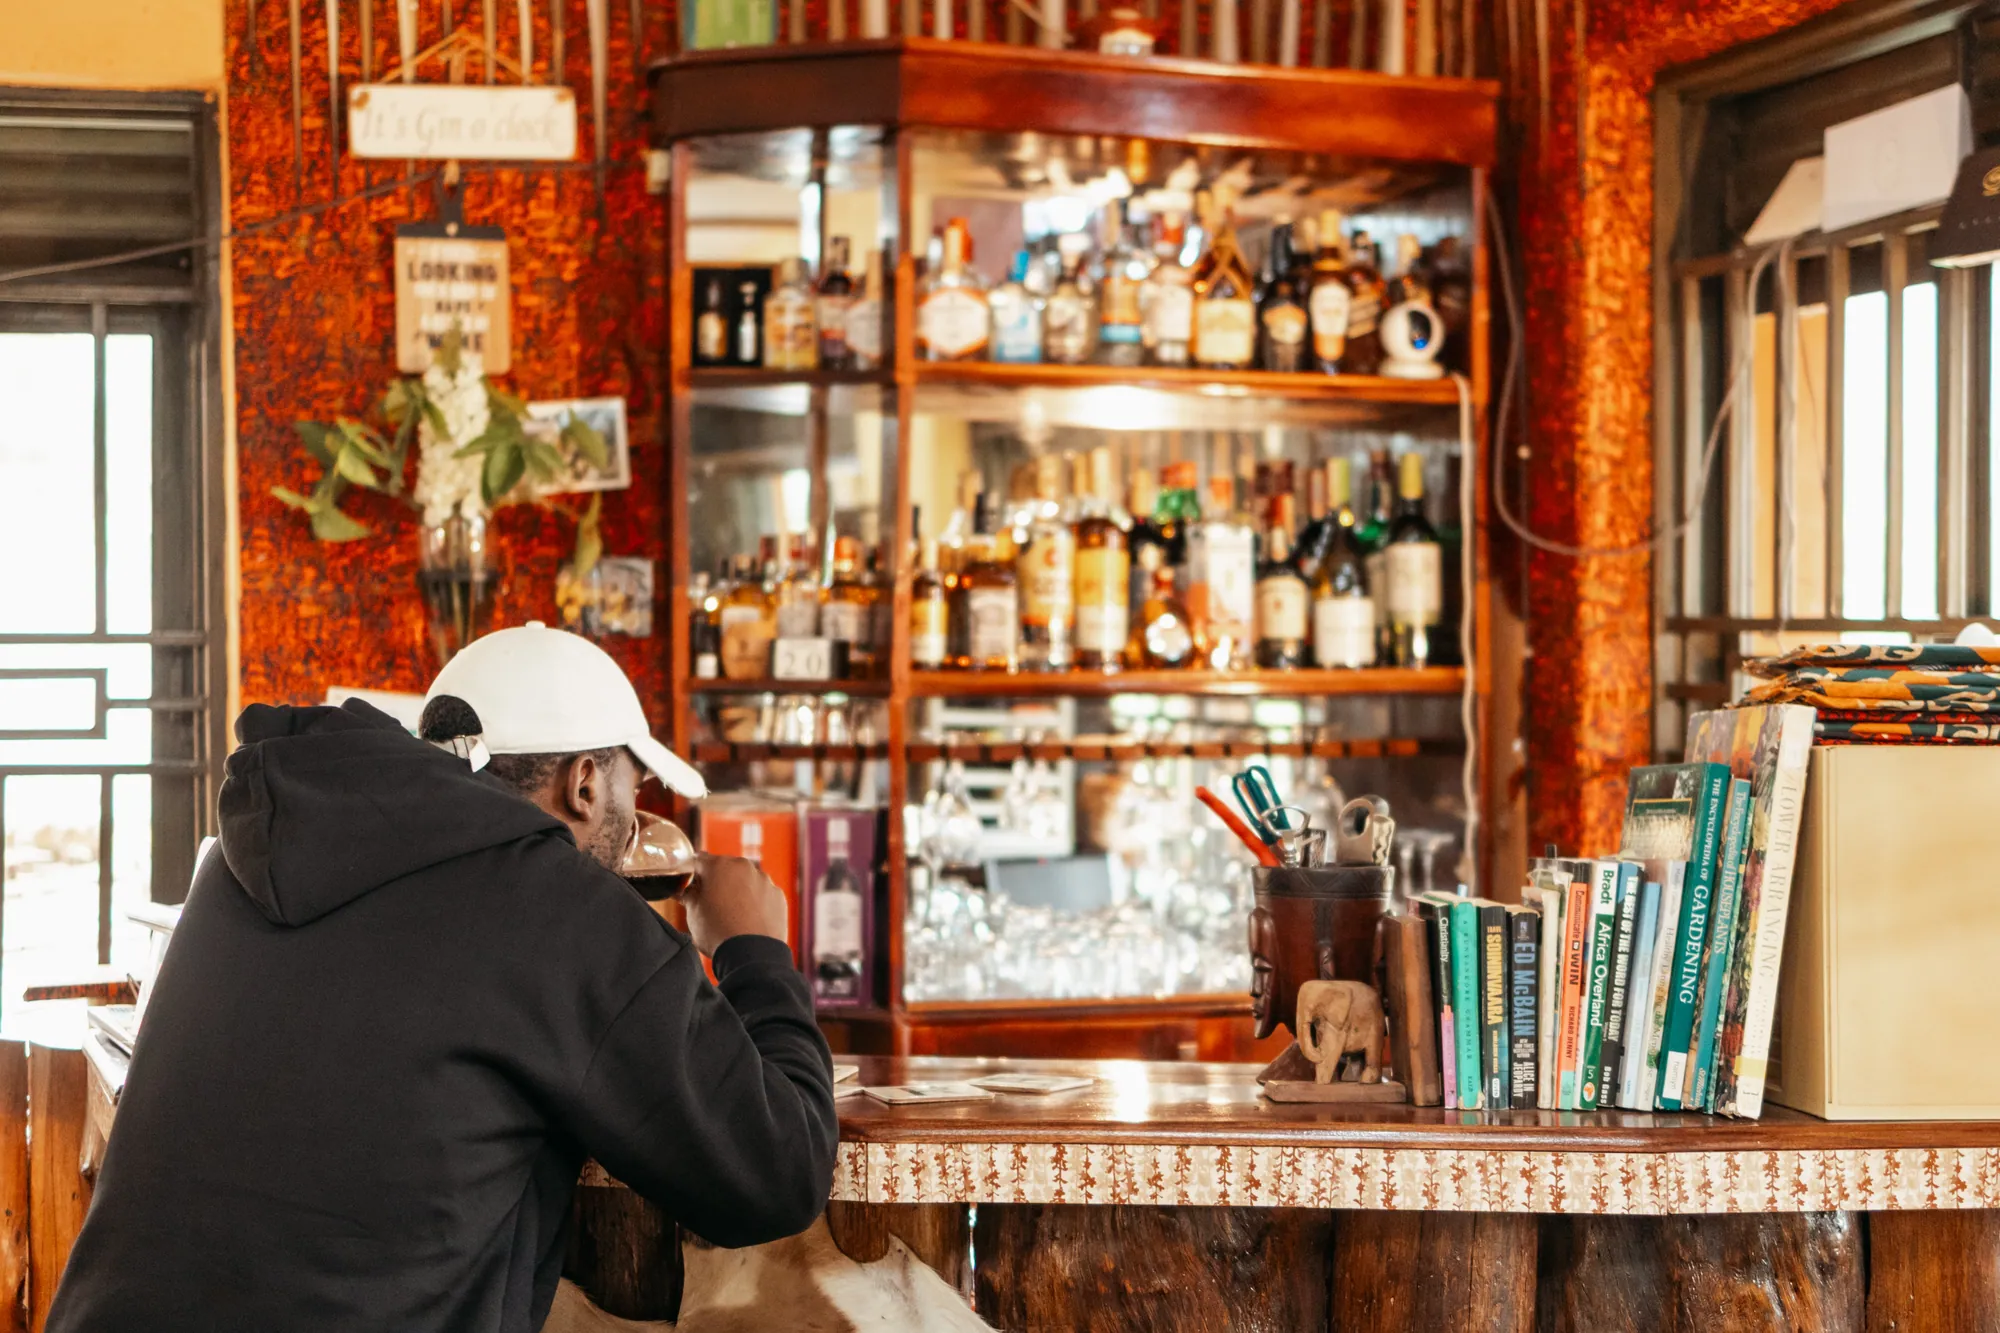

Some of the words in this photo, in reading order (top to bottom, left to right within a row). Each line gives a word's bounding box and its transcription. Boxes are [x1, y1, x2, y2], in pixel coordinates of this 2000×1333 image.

[408, 262, 498, 283] LOOKING
[1711, 778, 1721, 795] THE
[1734, 791, 1746, 806] The
[1773, 771, 1800, 853] LOWER
[1701, 798, 1719, 865] ENCYCLOPEDIA
[1699, 868, 1708, 880] OF
[1725, 860, 1736, 868] of
[1599, 869, 1613, 904] Bradt
[1625, 876, 1638, 893] THE
[1571, 890, 1584, 938] Communicate
[1622, 895, 1636, 918] BEST
[1713, 870, 1736, 953] HOUSEPLANTS
[1758, 863, 1789, 977] ARRANGING
[1438, 917, 1449, 961] Christianity
[1595, 921, 1609, 960] Africa
[1620, 920, 1633, 931] OF
[1513, 942, 1536, 963] ED
[1617, 934, 1632, 951] THE
[1660, 927, 1675, 961] Healthy
[1677, 884, 1709, 1004] GARDENING
[1485, 934, 1503, 1025] SOININVAARA
[1568, 953, 1580, 985] WIN
[1613, 953, 1628, 984] WORD
[1512, 969, 1536, 1035] McBAIN
[1589, 964, 1606, 1026] Overland
[1611, 987, 1624, 1007] FOR
[1464, 1008, 1472, 1059] GRAMMAR
[1566, 1005, 1576, 1034] RICHARD
[1606, 1010, 1622, 1041] TODAY
[1564, 1036, 1573, 1059] DENNY
[1512, 1062, 1523, 1097] JEOPARDY
[1523, 1062, 1534, 1081] ALICE
[1523, 1083, 1534, 1091] IN
[1601, 1066, 1612, 1081] Bob
